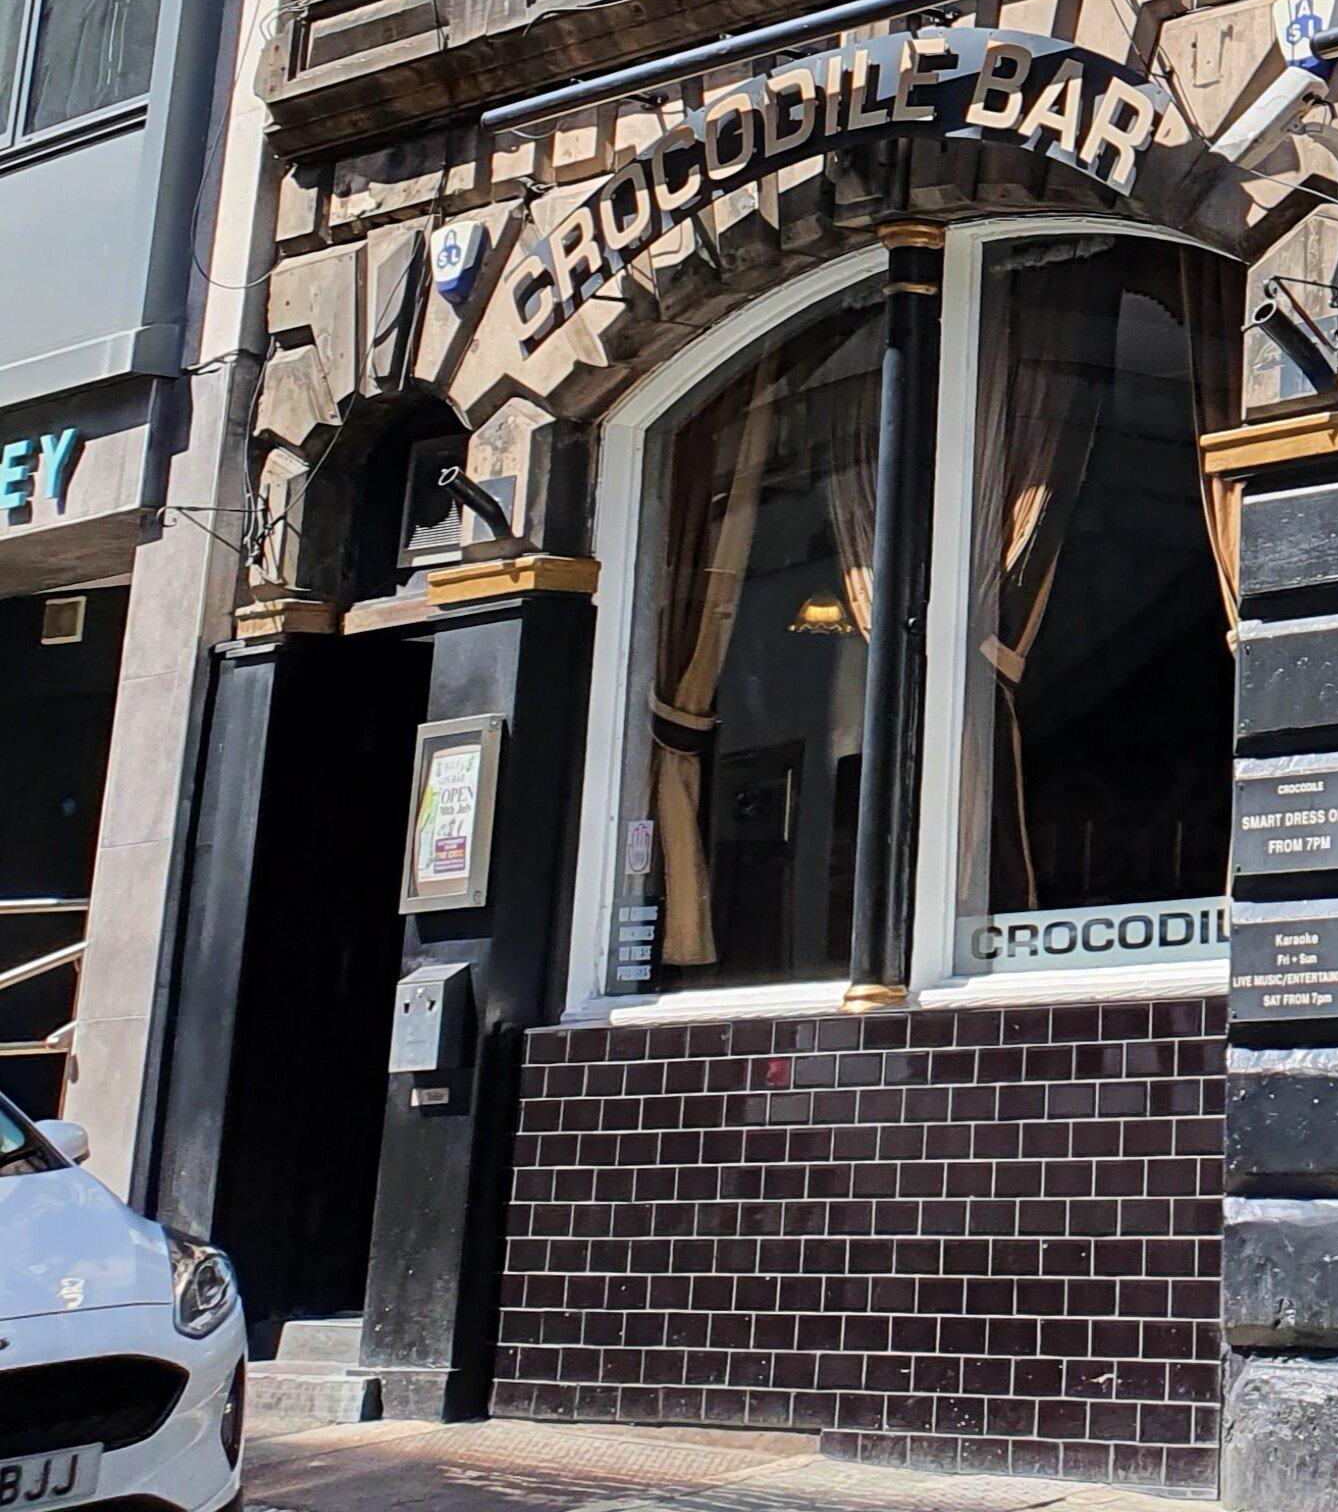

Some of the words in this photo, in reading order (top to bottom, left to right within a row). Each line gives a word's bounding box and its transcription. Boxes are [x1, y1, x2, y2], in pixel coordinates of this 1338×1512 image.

[504, 37, 957, 343] CROCODILE
[966, 43, 1155, 184] BAR
[1277, 781, 1324, 795] CROCODILE
[1242, 813, 1282, 830] SMART
[1285, 810, 1326, 827] DRESS
[1268, 838, 1303, 854] FROM
[1306, 836, 1331, 851] 7PM
[1275, 933, 1319, 947] Karaoke
[1233, 975, 1252, 988] LIVE
[1263, 994, 1282, 1007] SAT
[1283, 993, 1310, 1006] FROM
[1311, 992, 1333, 1006] 7pm
